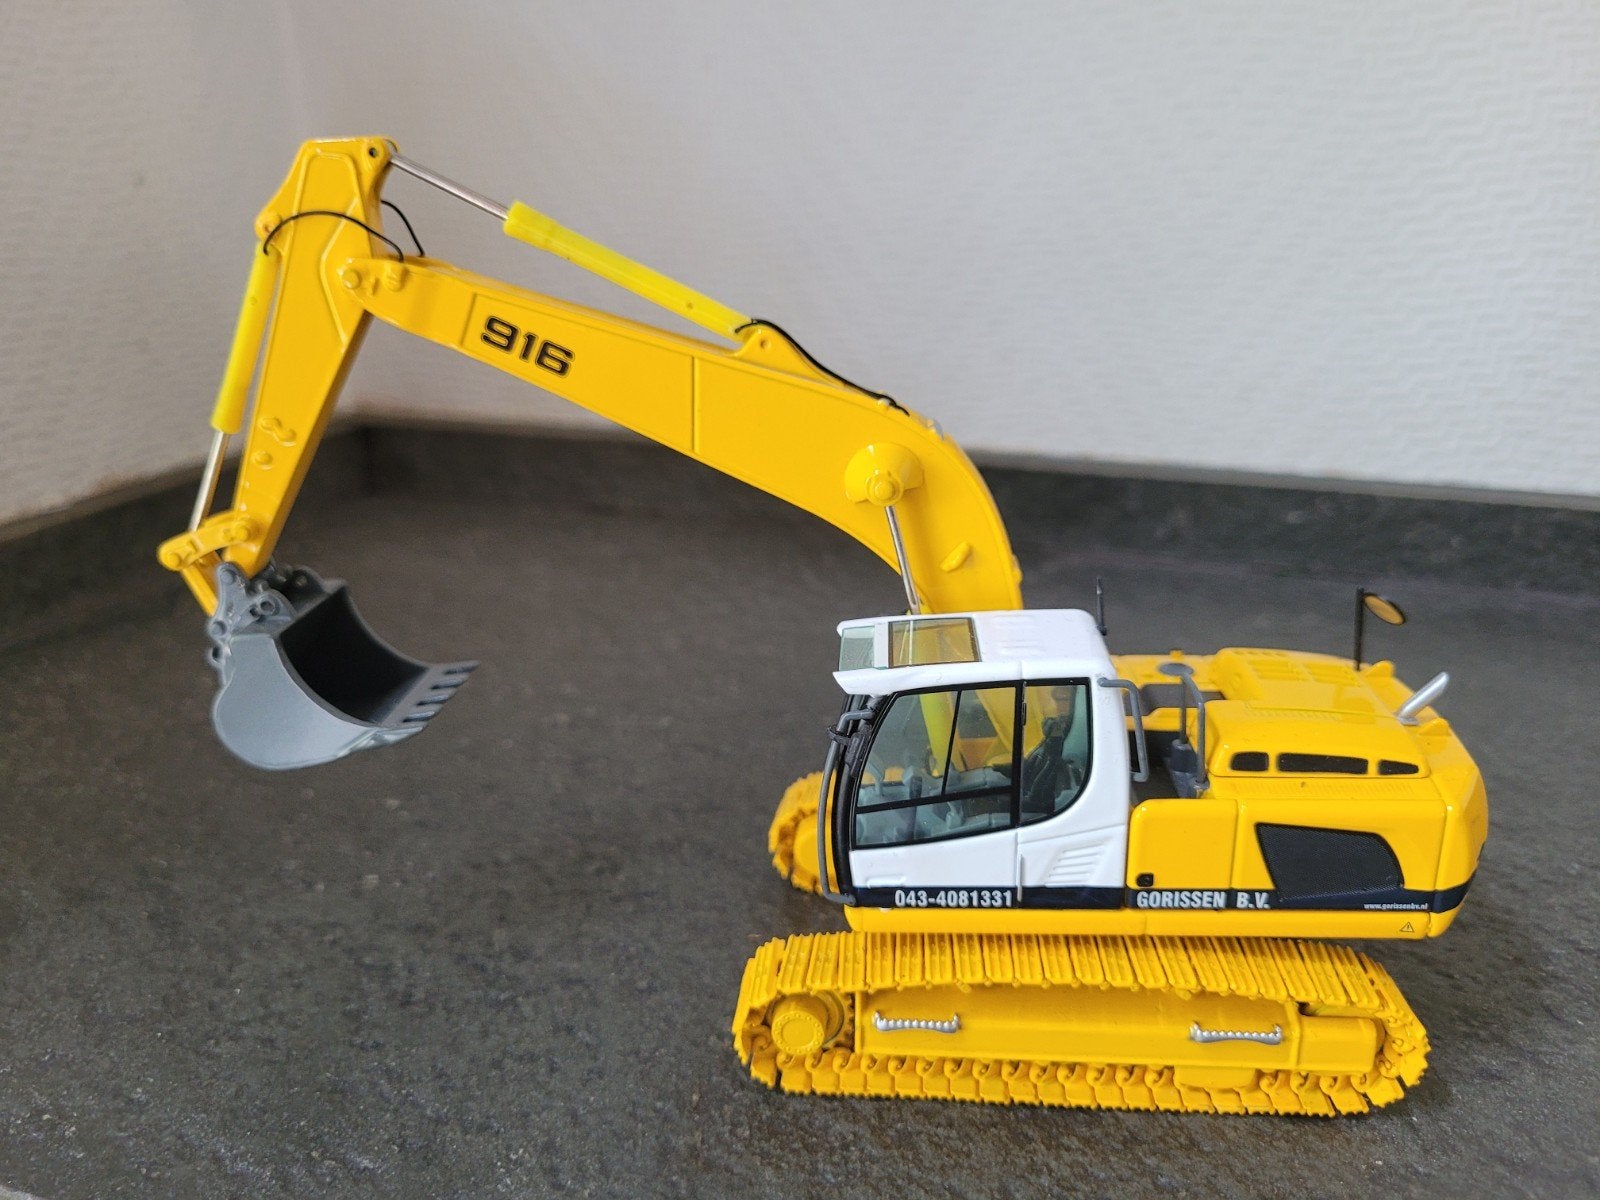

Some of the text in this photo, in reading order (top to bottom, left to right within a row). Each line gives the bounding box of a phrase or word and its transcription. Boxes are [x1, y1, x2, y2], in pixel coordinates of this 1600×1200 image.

[481, 315, 576, 378] 916
[894, 889, 1012, 908] 043-4081331
[1136, 890, 1271, 909] GORISSEN B.V.
[1363, 902, 1429, 911] www.gorissenbv.nl
